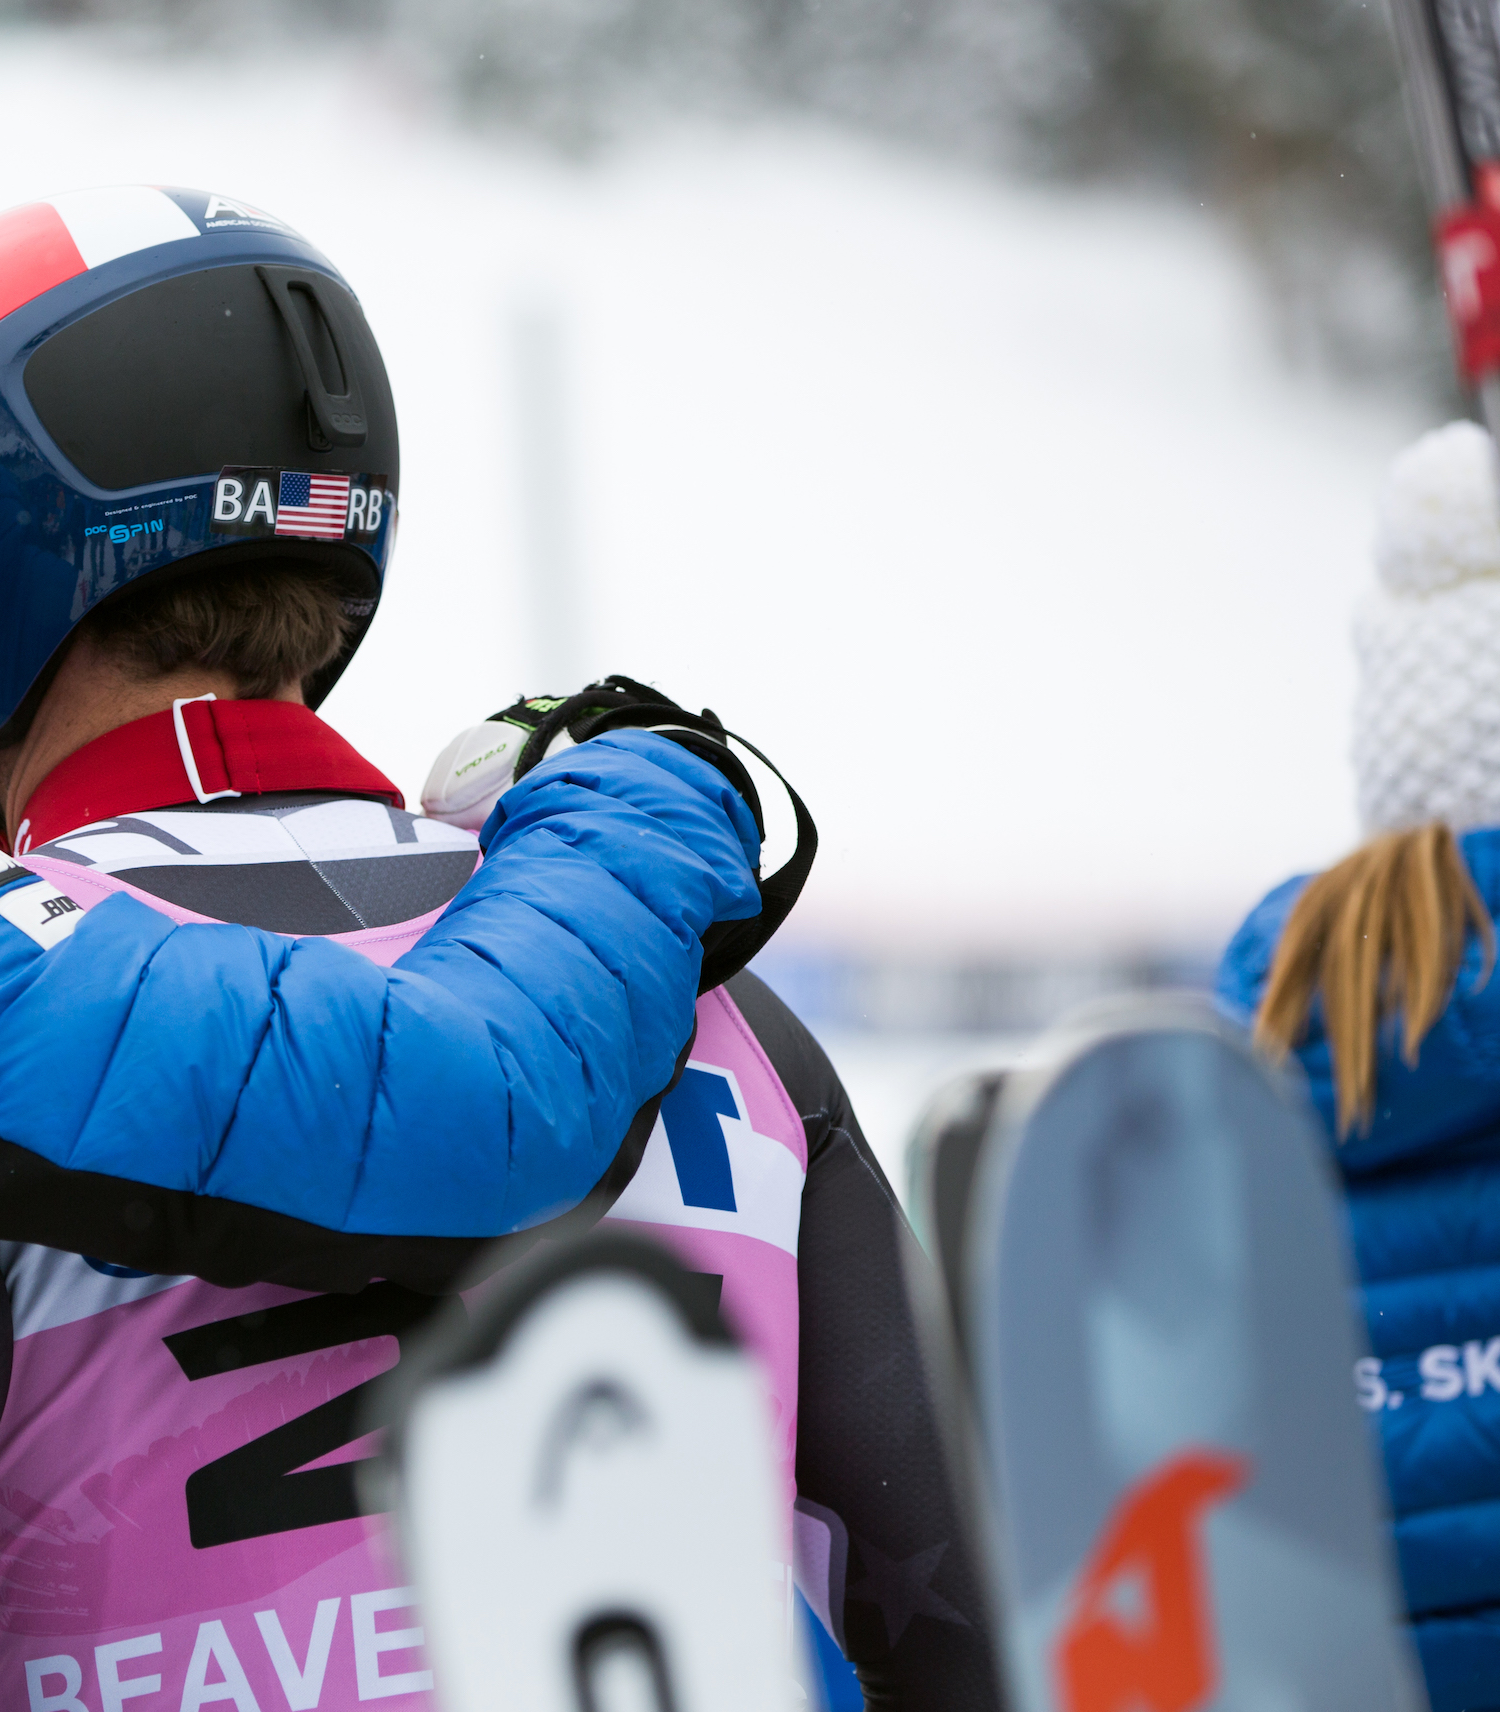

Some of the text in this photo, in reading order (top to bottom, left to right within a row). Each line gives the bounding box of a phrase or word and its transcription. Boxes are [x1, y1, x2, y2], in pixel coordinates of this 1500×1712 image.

[104, 506, 133, 517] Designed
[140, 498, 174, 509] engineered
[184, 493, 198, 501] POC
[109, 519, 164, 544] SPIN
